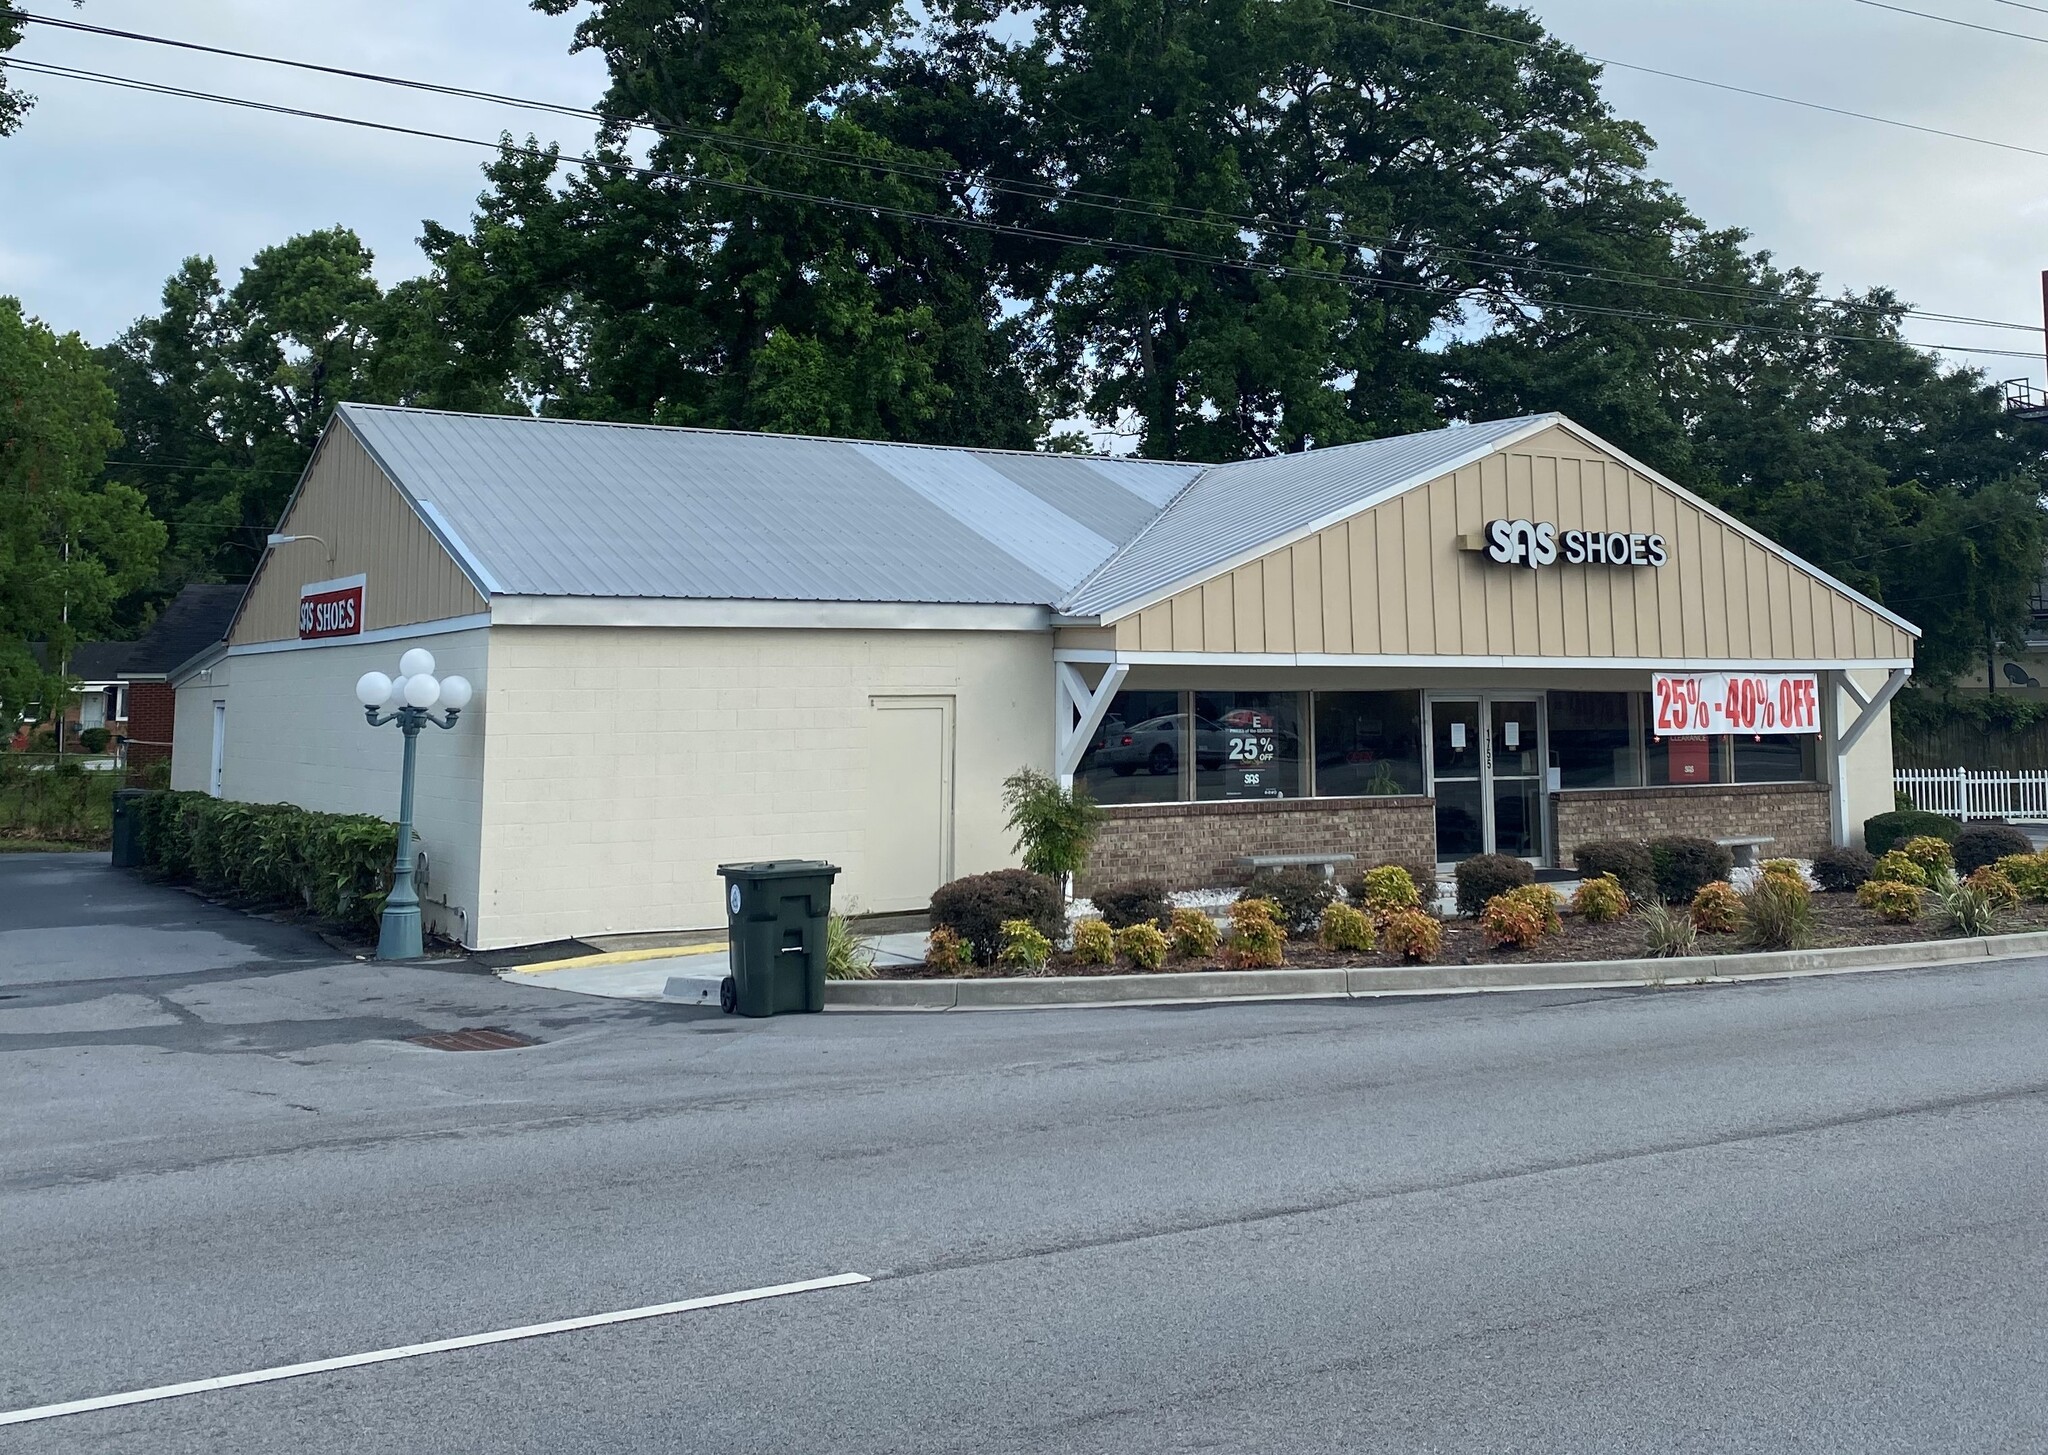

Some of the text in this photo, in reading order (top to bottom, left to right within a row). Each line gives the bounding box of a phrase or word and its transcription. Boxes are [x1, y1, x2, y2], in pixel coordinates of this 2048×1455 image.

[1486, 518, 1669, 570] SAS SHOES
[300, 597, 355, 634] SAS SHOES
[1656, 677, 1710, 730] 25%
[1725, 677, 1775, 729] 40%
[1779, 678, 1816, 729] OFF
[1244, 774, 1259, 784] SAS
